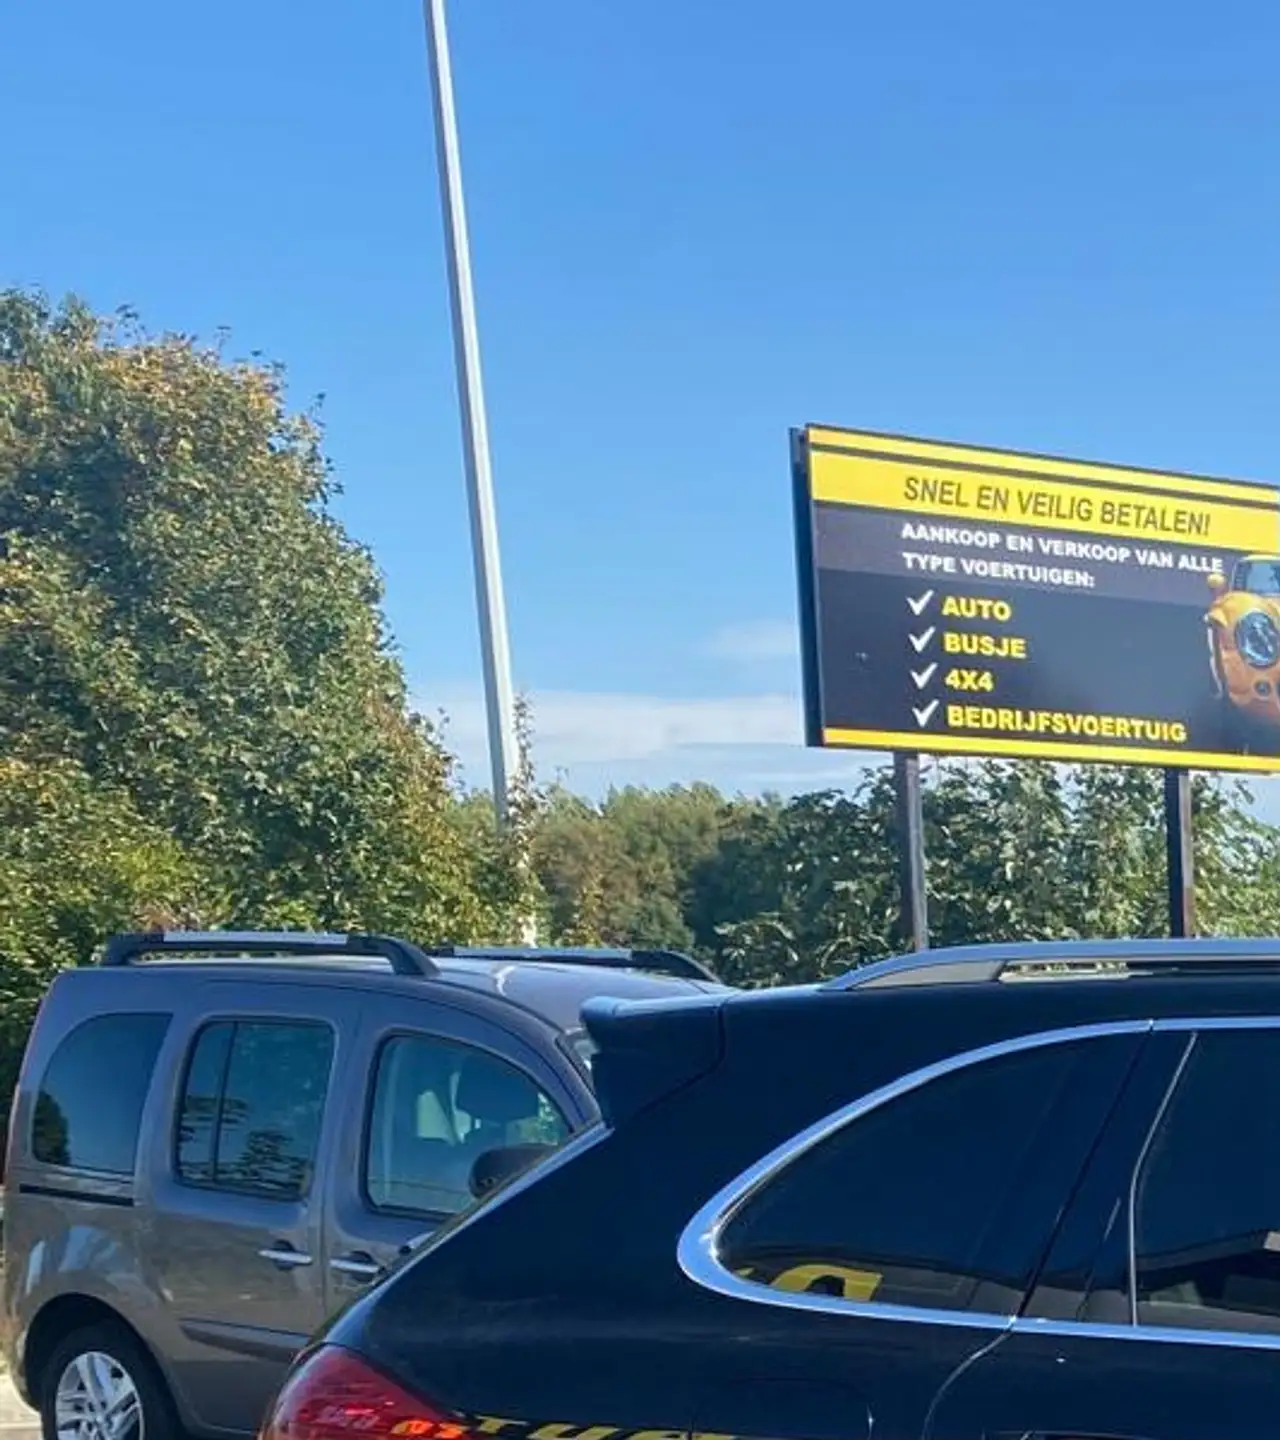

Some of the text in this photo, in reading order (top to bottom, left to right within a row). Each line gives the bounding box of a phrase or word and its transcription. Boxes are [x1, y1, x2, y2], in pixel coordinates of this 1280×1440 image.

[904, 477, 1211, 536] SNEL EN VEILIG BETALEN!
[902, 522, 1224, 573] AANKOOP EN VERKOOP VAN ALLE
[902, 552, 1095, 588] TYPE VOERTUIGEN:
[941, 595, 1012, 621] AUTO
[944, 631, 1027, 659] BUSJE
[945, 668, 994, 691] 4X4
[948, 705, 1187, 743] BEDRIJFSVOERTUIG
